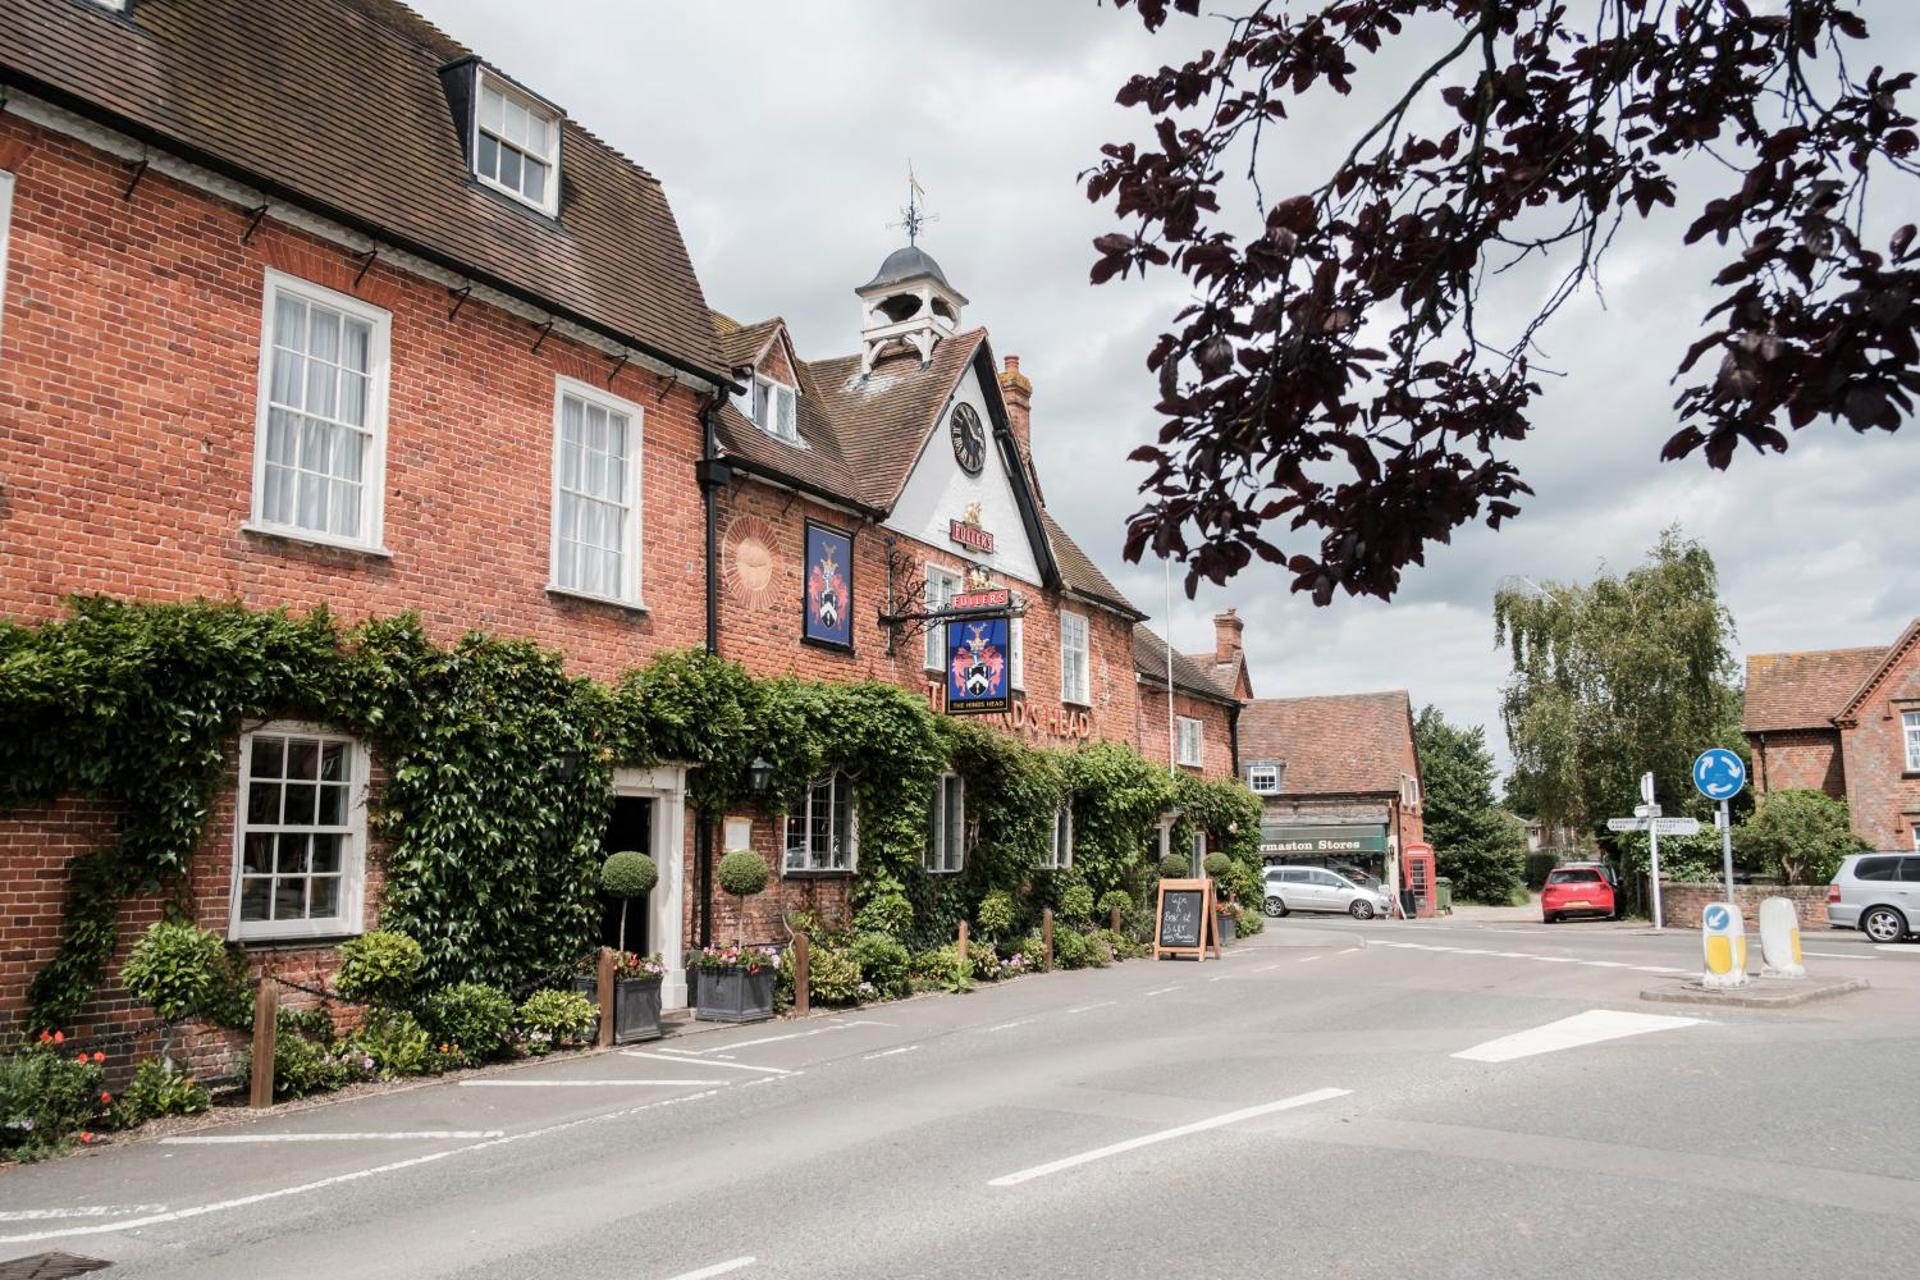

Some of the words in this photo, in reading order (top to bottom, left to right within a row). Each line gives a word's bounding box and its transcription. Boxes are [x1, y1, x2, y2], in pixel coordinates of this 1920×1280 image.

[1046, 707, 1090, 738] HEAD
[1259, 841, 1312, 851] rmaston
[1318, 840, 1360, 850] Stores
